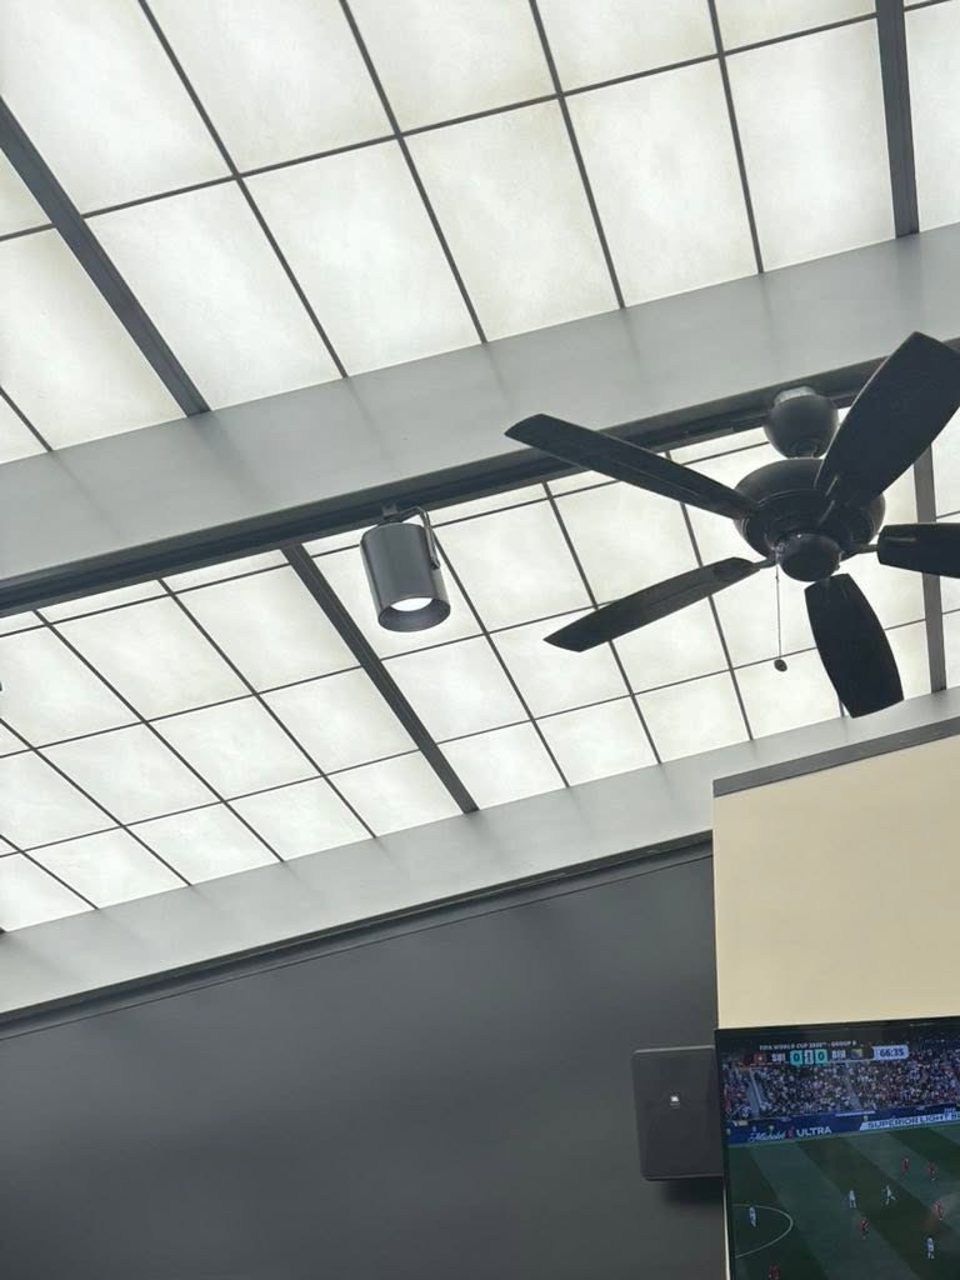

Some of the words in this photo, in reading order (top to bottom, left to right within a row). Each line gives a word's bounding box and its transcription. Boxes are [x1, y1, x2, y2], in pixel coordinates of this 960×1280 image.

[793, 1053, 800, 1062] 0
[818, 1051, 825, 1061] 0
[880, 1047, 904, 1057] 66:35
[868, 1117, 919, 1130] SUPERIOR
[796, 1126, 832, 1137] ULTRA
